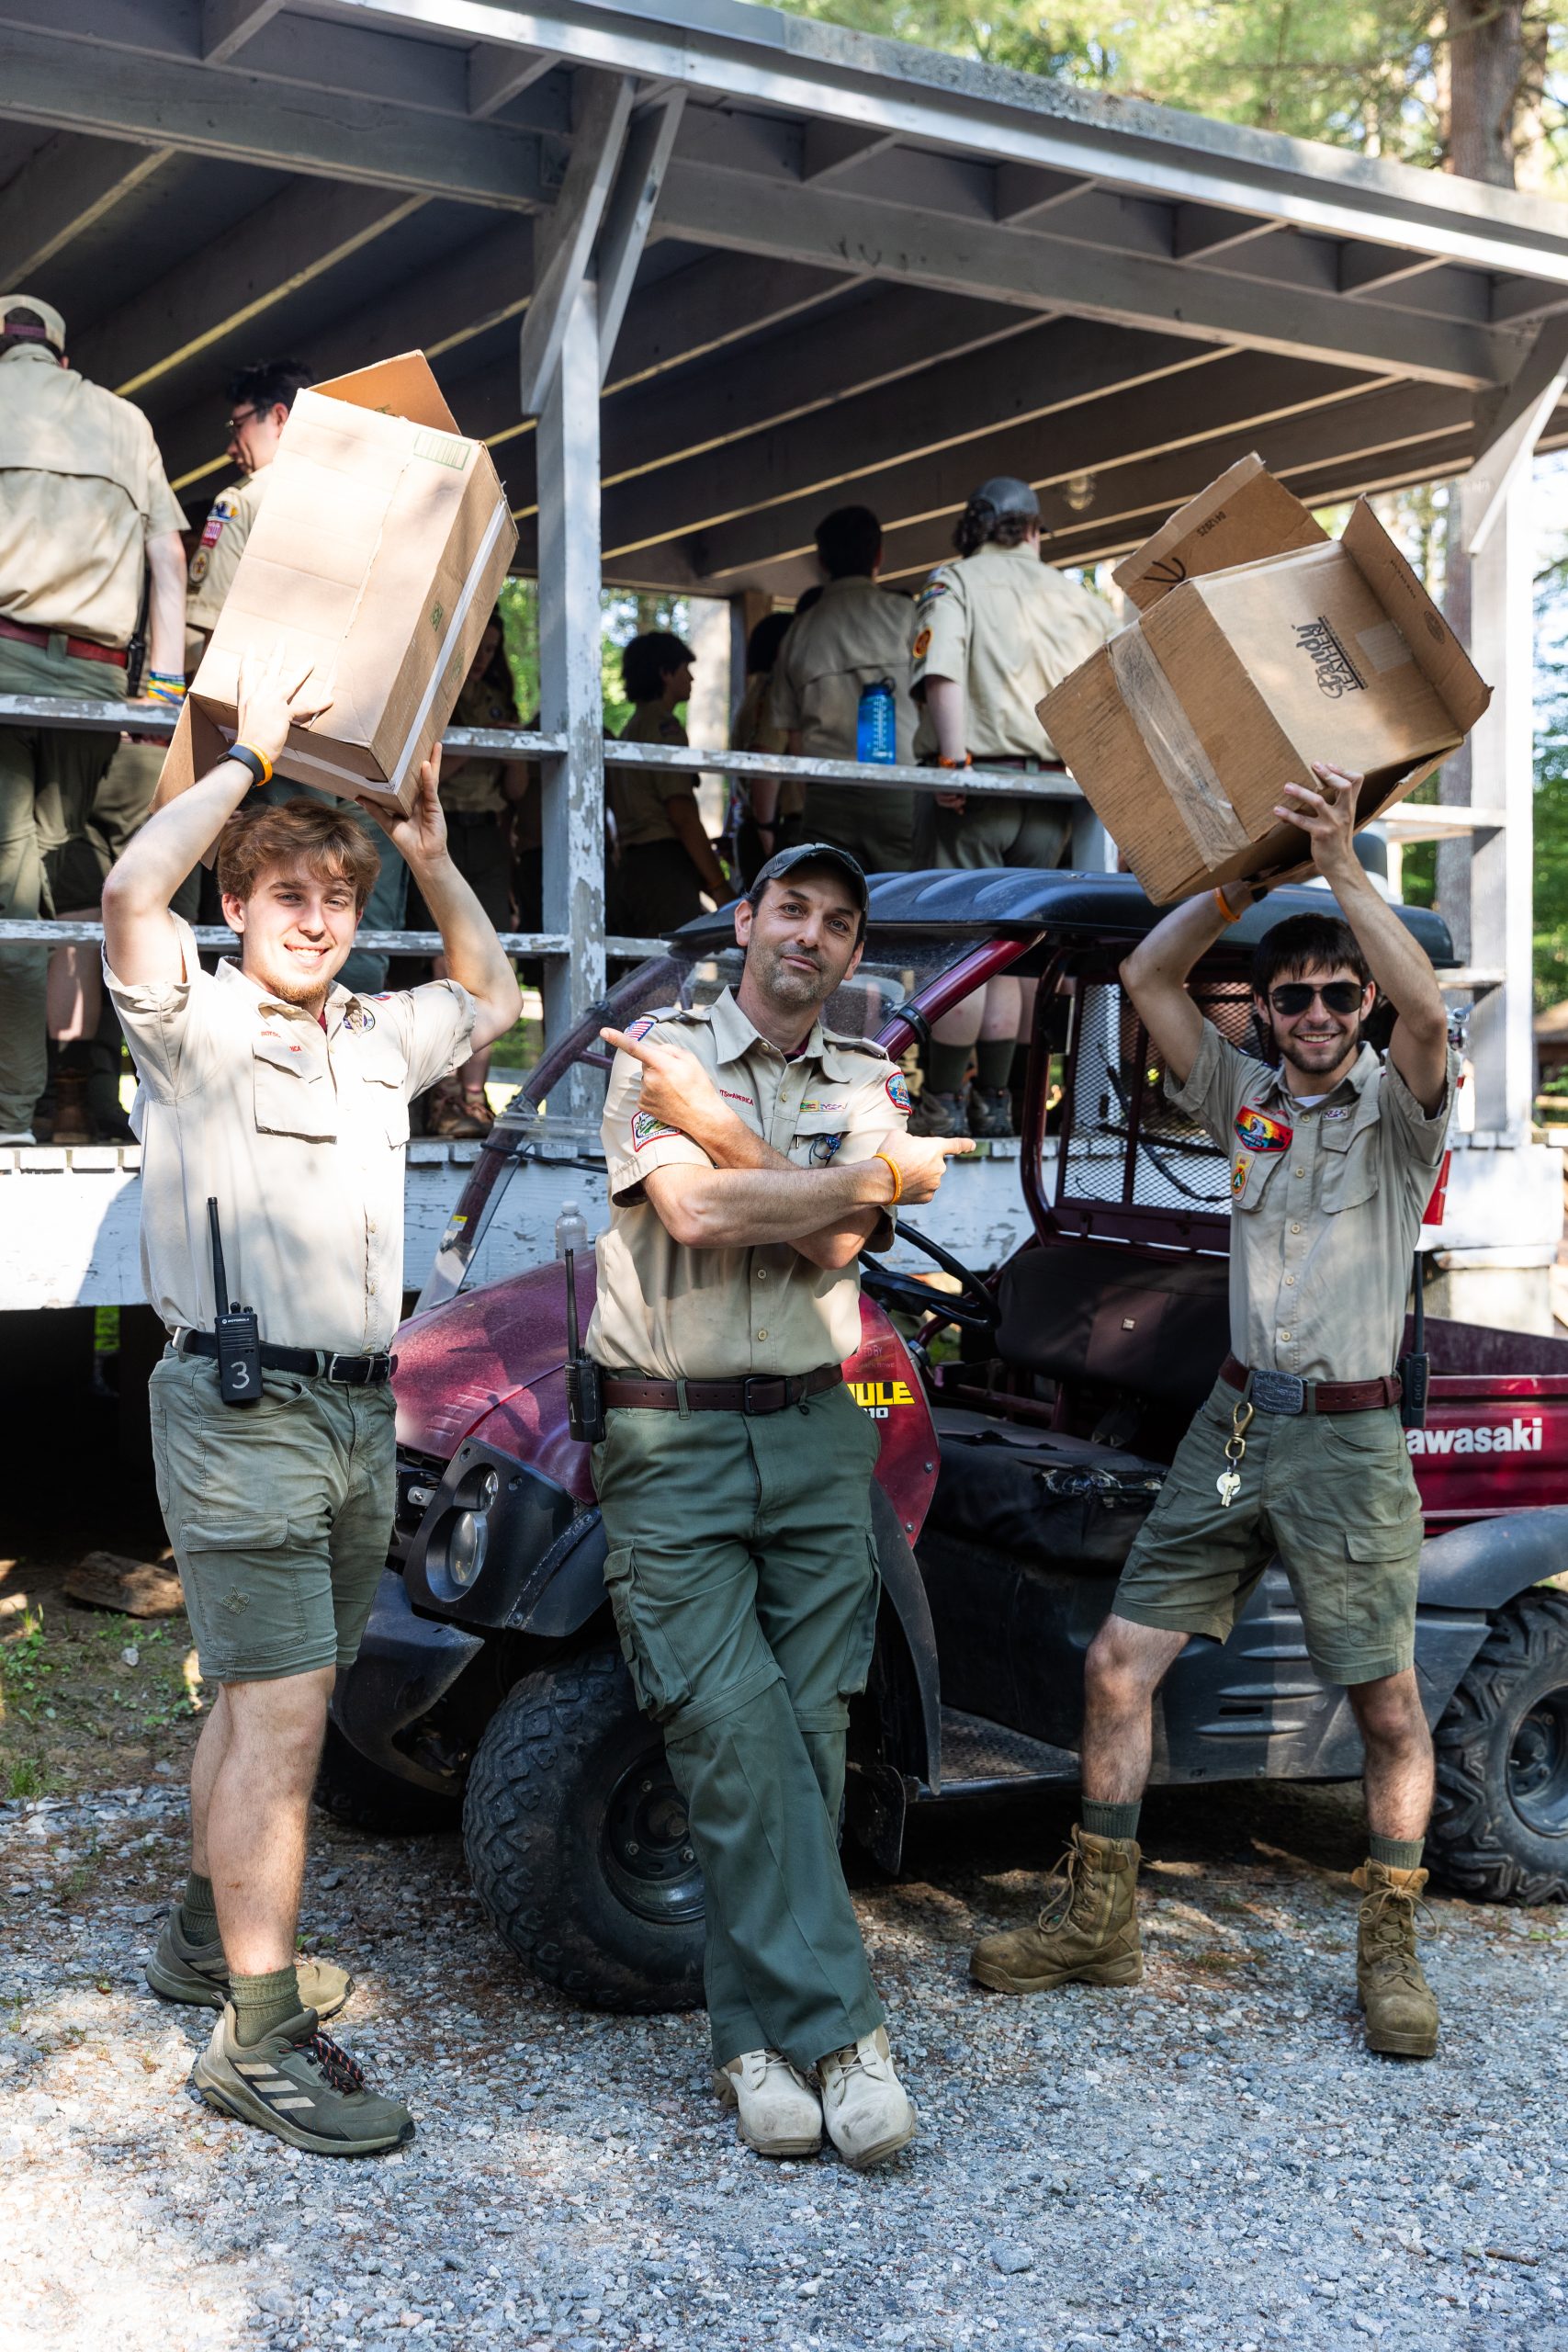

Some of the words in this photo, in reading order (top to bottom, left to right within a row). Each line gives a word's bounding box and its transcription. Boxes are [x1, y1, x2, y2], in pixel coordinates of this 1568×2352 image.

[1314, 626, 1359, 691] LEATHER
[231, 1361, 250, 1389] 3
[847, 1382, 915, 1407] ULE
[863, 1407, 888, 1419] 10
[1405, 1418, 1542, 1454] awasaki
